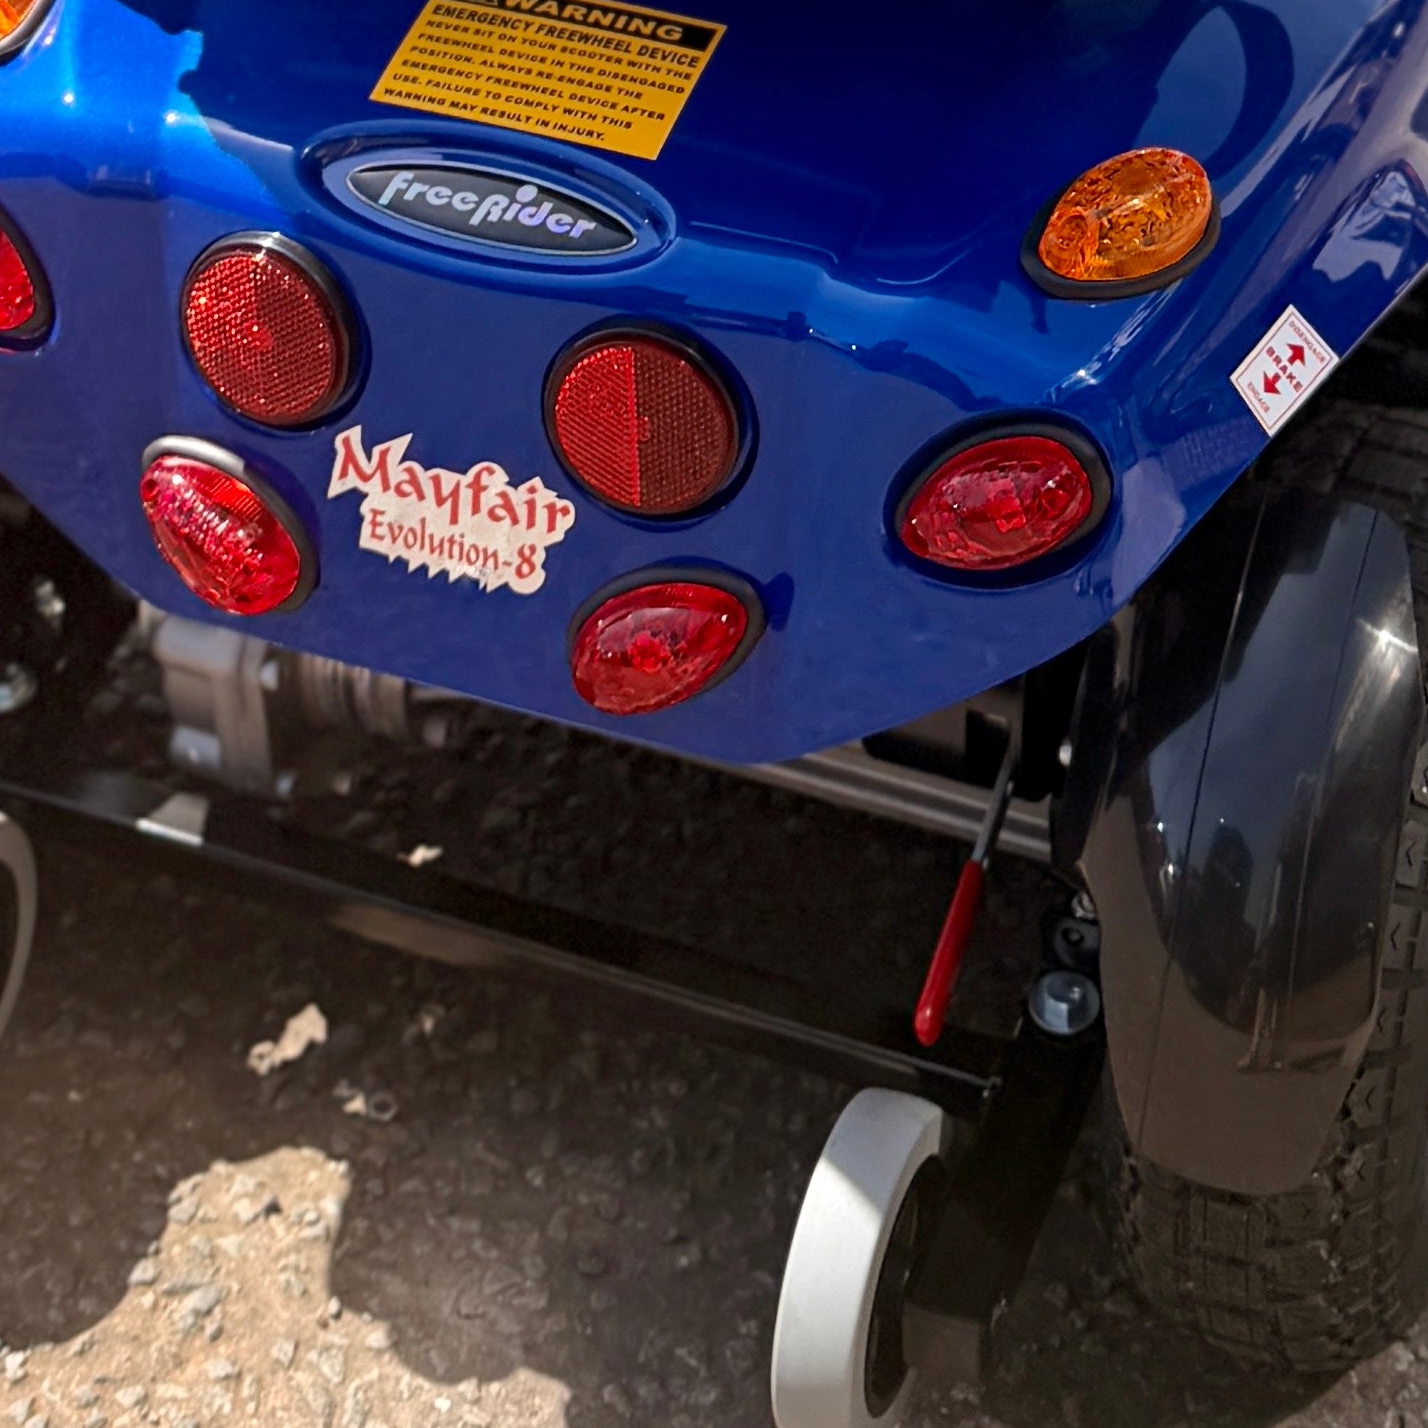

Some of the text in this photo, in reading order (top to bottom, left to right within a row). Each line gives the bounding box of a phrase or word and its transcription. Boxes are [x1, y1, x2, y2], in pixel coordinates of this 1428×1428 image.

[418, 33, 685, 94] FREEWHEEL DEVICE IN THE DISENGAGED
[426, 20, 692, 80] NEVER SIT ON YOUR SCOOTER WITH THE
[432, 4, 700, 68] EMERGENCY FREEWHEEL DEVICE
[392, 73, 633, 129] USE. FAILURE TO COMPLY WITH THIS
[401, 59, 665, 120] EMERGENCY FREEWHEEL DEVICE AFTER
[410, 45, 475, 64] POSITION.
[479, 59, 533, 76] ALWAYS
[616, 87, 643, 100] THE
[384, 88, 605, 141] WARNING MAY RESULT IN INJURY.
[378, 171, 596, 238] freeRider
[1266, 346, 1303, 393] BRAKE
[337, 434, 570, 534] Mayfair
[369, 508, 537, 580] Evolution-8
